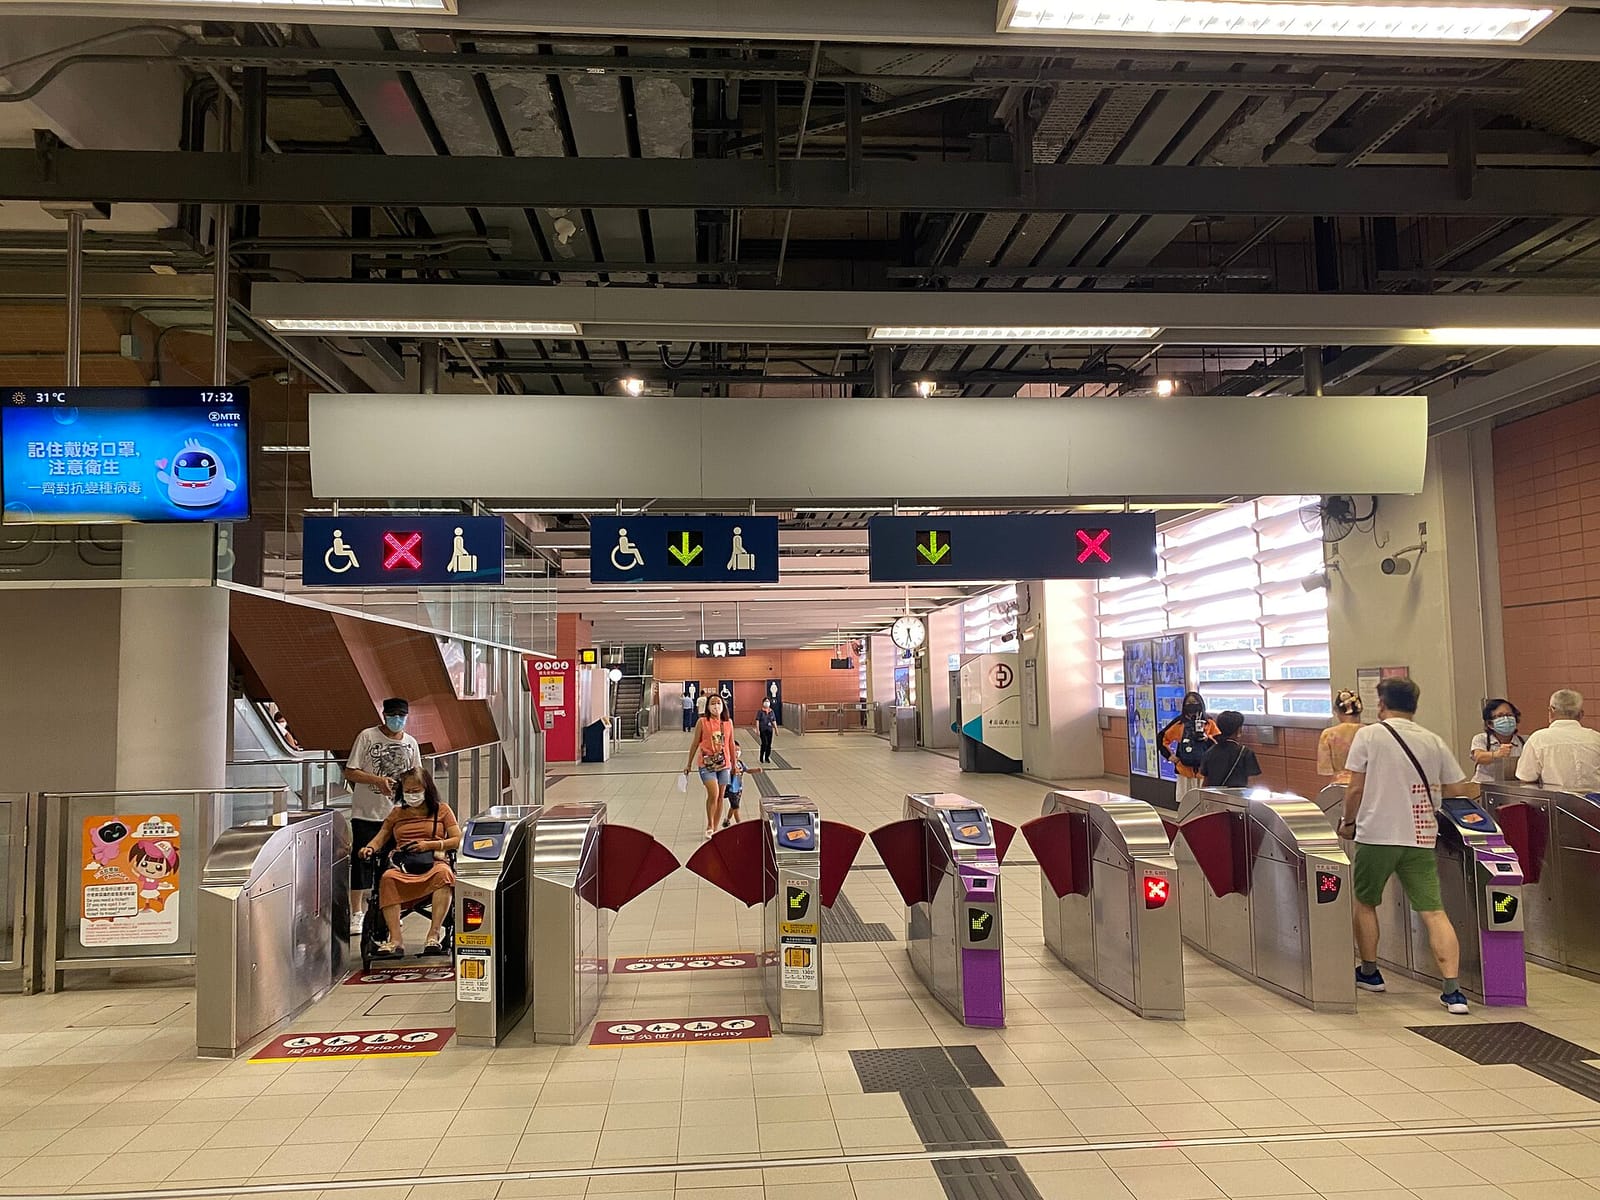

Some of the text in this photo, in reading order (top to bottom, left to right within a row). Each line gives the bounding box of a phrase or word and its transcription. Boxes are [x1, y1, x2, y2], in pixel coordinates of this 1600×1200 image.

[200, 392, 234, 402] 17:32
[220, 412, 241, 421] MTR
[28, 481, 142, 494] 一齊對抗變種病毒
[694, 1030, 743, 1038] Priority
[364, 1043, 416, 1052] Priority
